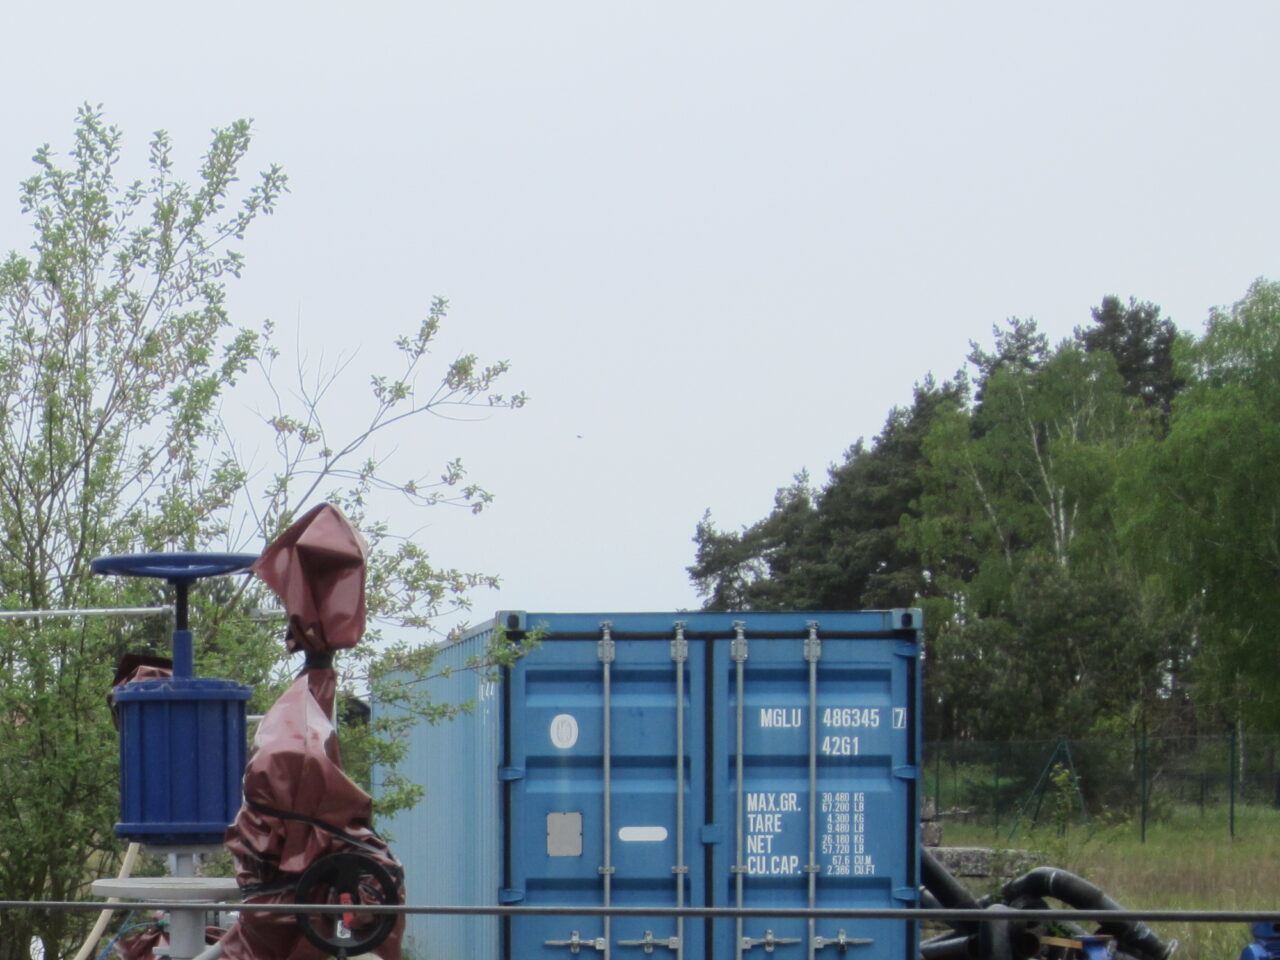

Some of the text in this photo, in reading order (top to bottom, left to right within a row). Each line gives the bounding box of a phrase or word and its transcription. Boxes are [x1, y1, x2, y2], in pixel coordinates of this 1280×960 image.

[760, 708, 906, 728] MGLU 486345 7
[822, 736, 859, 755] 42G1
[747, 793, 801, 812] MAX.GR.
[853, 792, 865, 802] KG
[747, 814, 782, 833] TARE
[853, 813, 865, 823] KG
[747, 835, 774, 854] NET
[853, 834, 865, 844] KG
[747, 856, 801, 875] CU.CAP.
